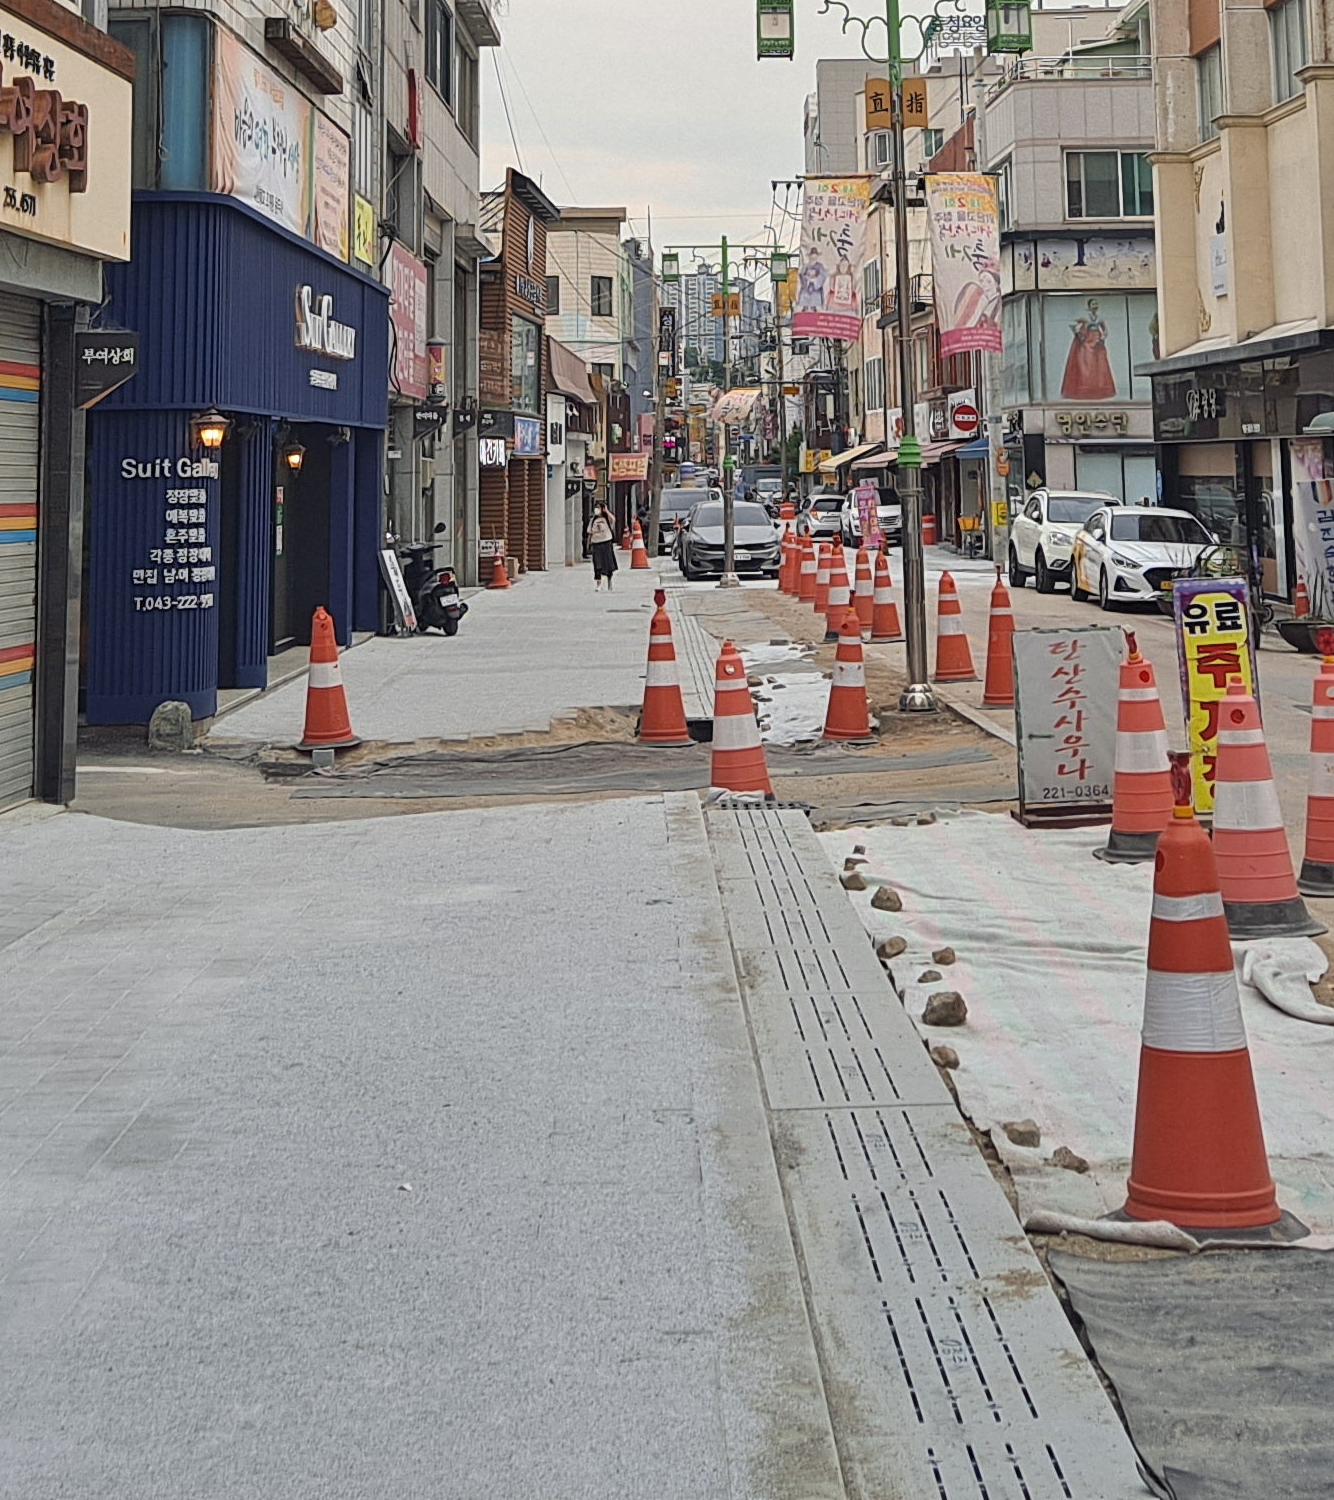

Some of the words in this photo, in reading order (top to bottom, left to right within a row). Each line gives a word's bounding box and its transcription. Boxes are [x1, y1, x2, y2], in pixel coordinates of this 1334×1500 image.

[81, 347, 135, 366] 부여상회
[121, 458, 172, 479] Suit
[1182, 601, 1243, 635] 유료
[1048, 639, 1094, 781] 탄산수사우나
[1043, 785, 1109, 800] 221-0364
